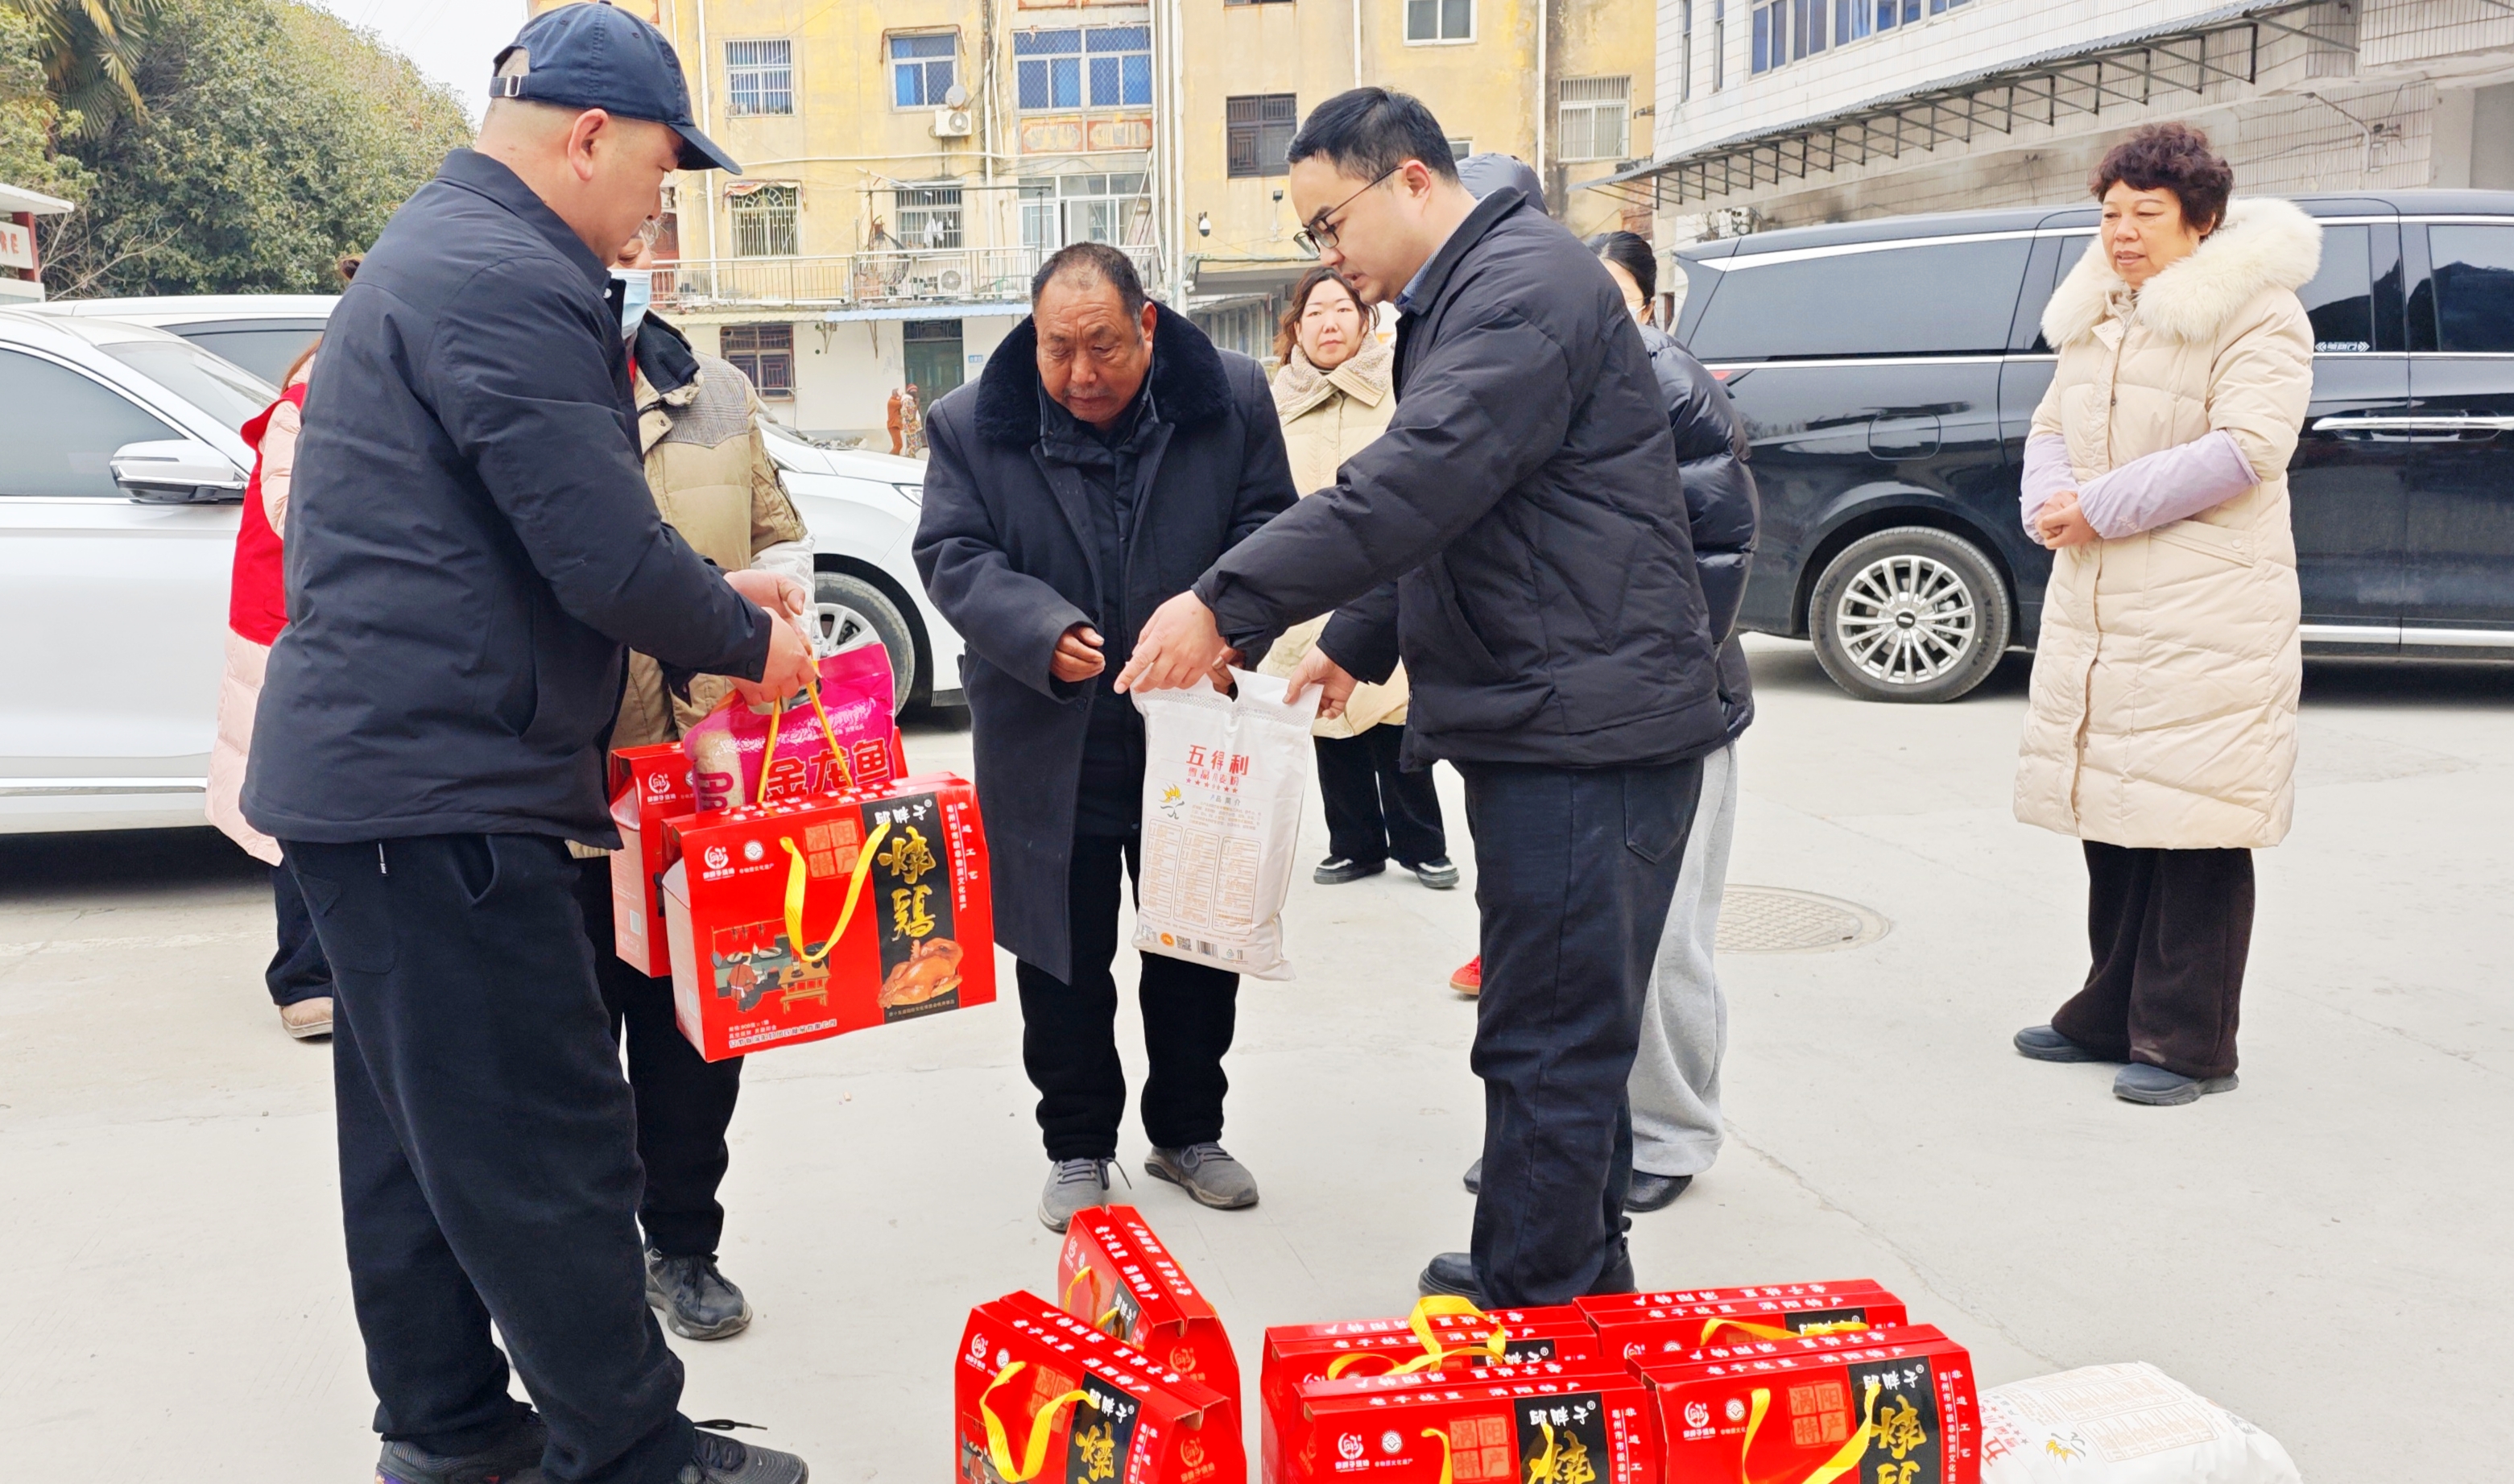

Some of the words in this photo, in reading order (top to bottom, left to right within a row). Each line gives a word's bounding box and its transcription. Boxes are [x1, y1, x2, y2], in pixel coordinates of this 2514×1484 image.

[1186, 744, 1249, 775] 五得利
[875, 804, 927, 825] 邱胖子
[1210, 794, 1240, 806] 产品简介
[1863, 1370, 1918, 1390] 邱胖子
[1089, 1388, 1127, 1424] 邱胖子
[1791, 1384, 1842, 1414] 涡阳
[1529, 1406, 1589, 1427] 邱胖子
[1795, 1415, 1843, 1444] 特产
[1452, 1420, 1506, 1449] 涡阳
[1453, 1450, 1506, 1479] 特产
